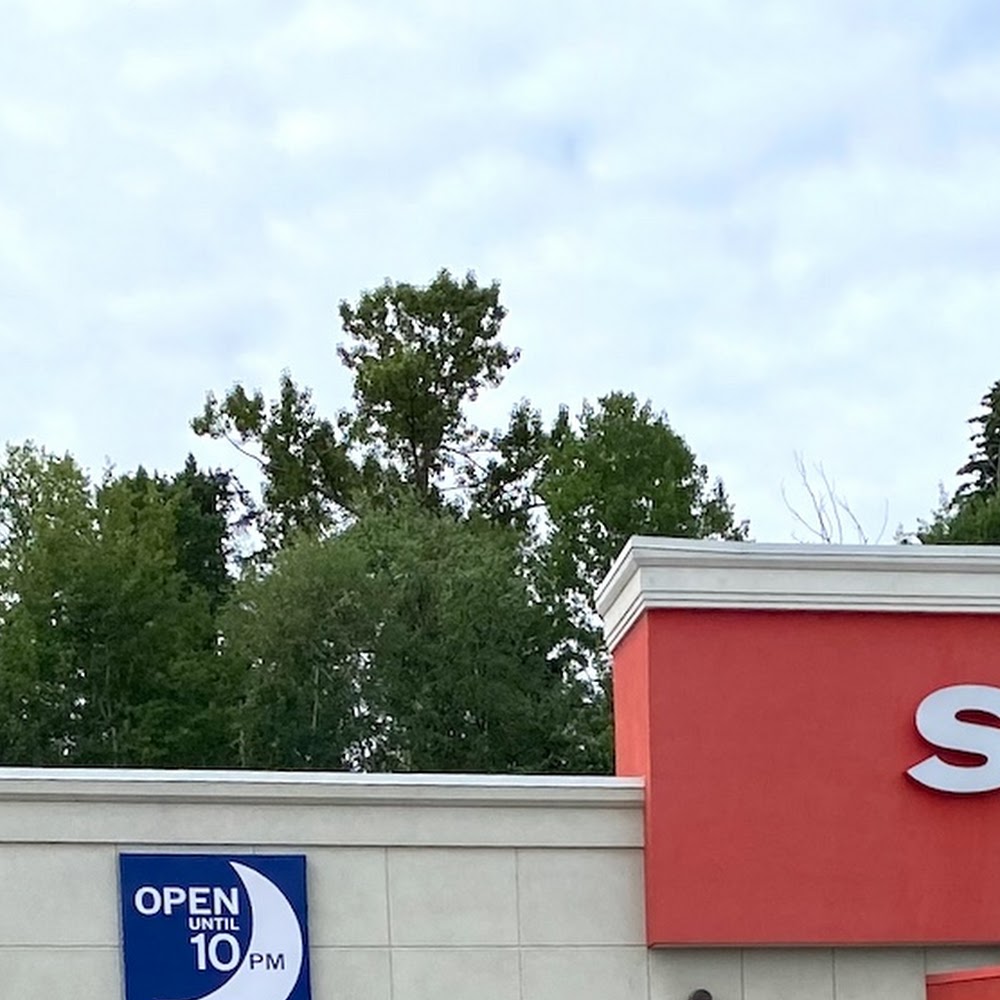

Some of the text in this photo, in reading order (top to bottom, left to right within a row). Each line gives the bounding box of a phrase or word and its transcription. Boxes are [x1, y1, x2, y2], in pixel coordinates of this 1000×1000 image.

[134, 886, 240, 916] OPEN
[188, 917, 240, 931] UNTIL
[190, 932, 285, 972] 10 PM
